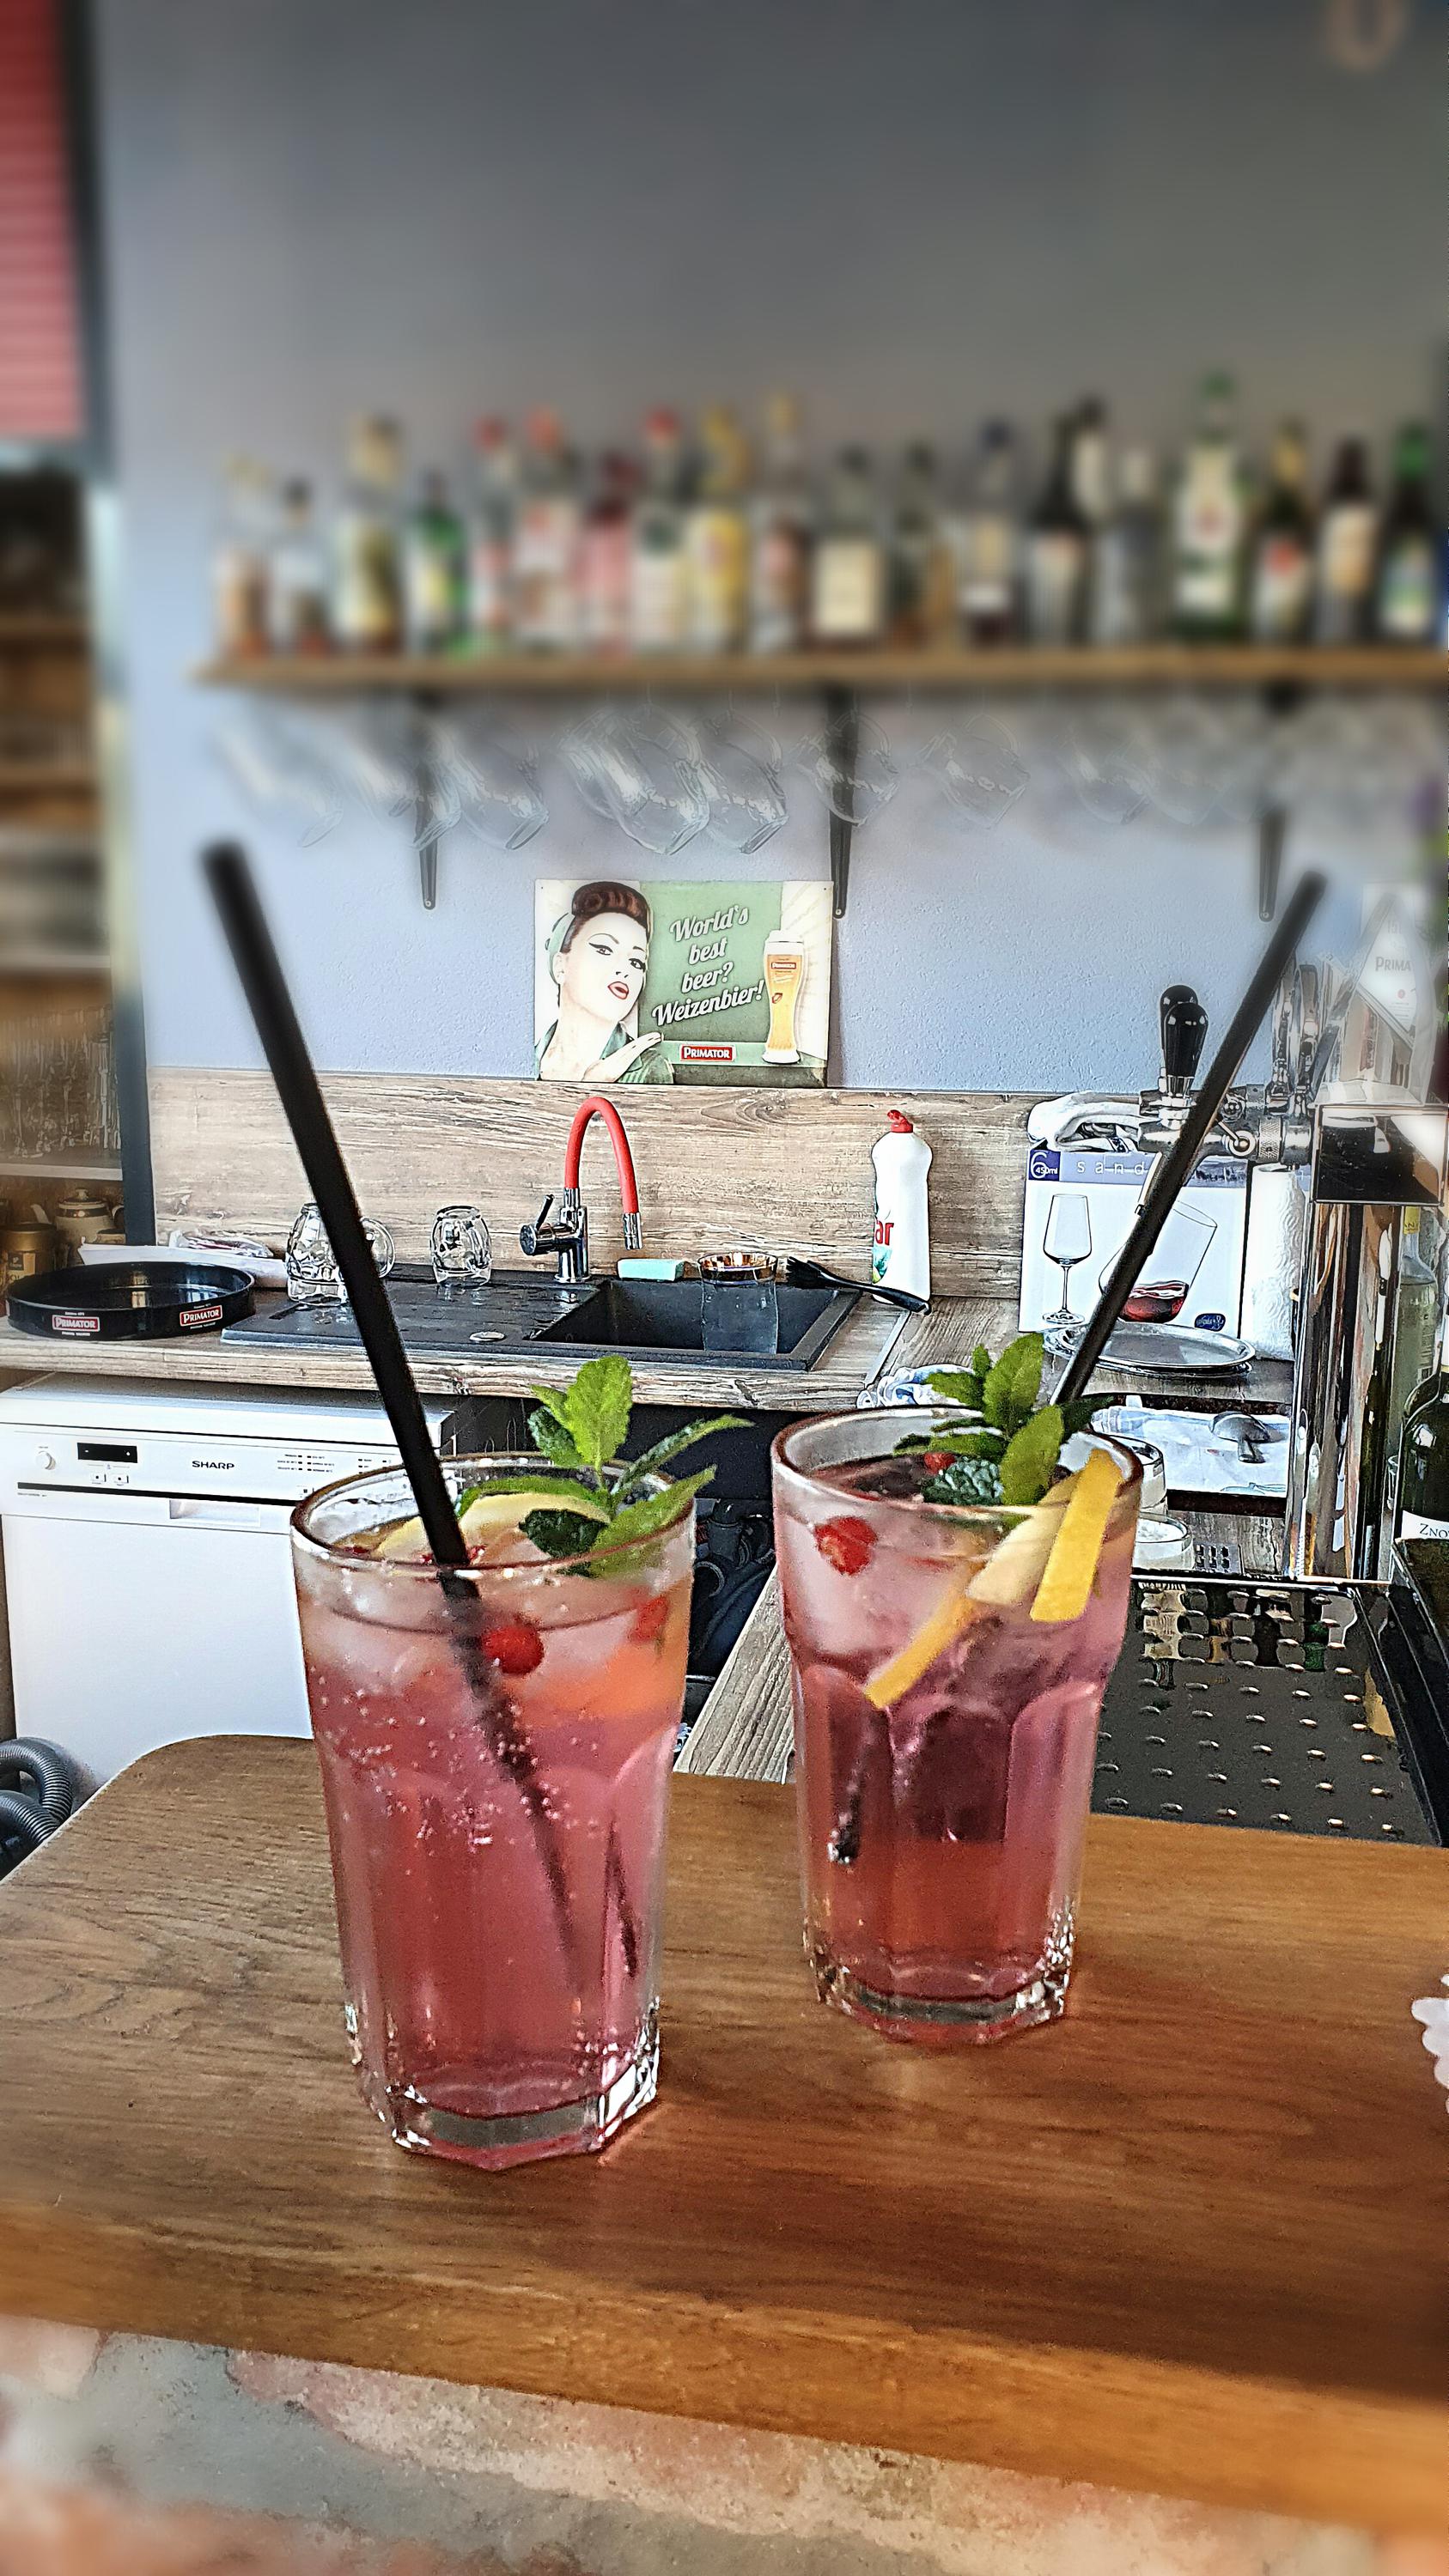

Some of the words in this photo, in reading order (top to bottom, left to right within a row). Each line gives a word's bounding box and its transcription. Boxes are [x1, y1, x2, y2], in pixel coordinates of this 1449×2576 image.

[670, 905, 749, 942] World's
[689, 937, 728, 964] best
[681, 962, 734, 993] beer?
[652, 979, 765, 1026] Weizenbier!
[684, 1047, 730, 1059] PRIMATOR
[1031, 1151, 1047, 1179] 6
[55, 1316, 95, 1328] PRIMATOR
[183, 1309, 220, 1323] PRIMATOR
[192, 1460, 235, 1470] SHARP
[1419, 1522, 1449, 1539] ZNO
